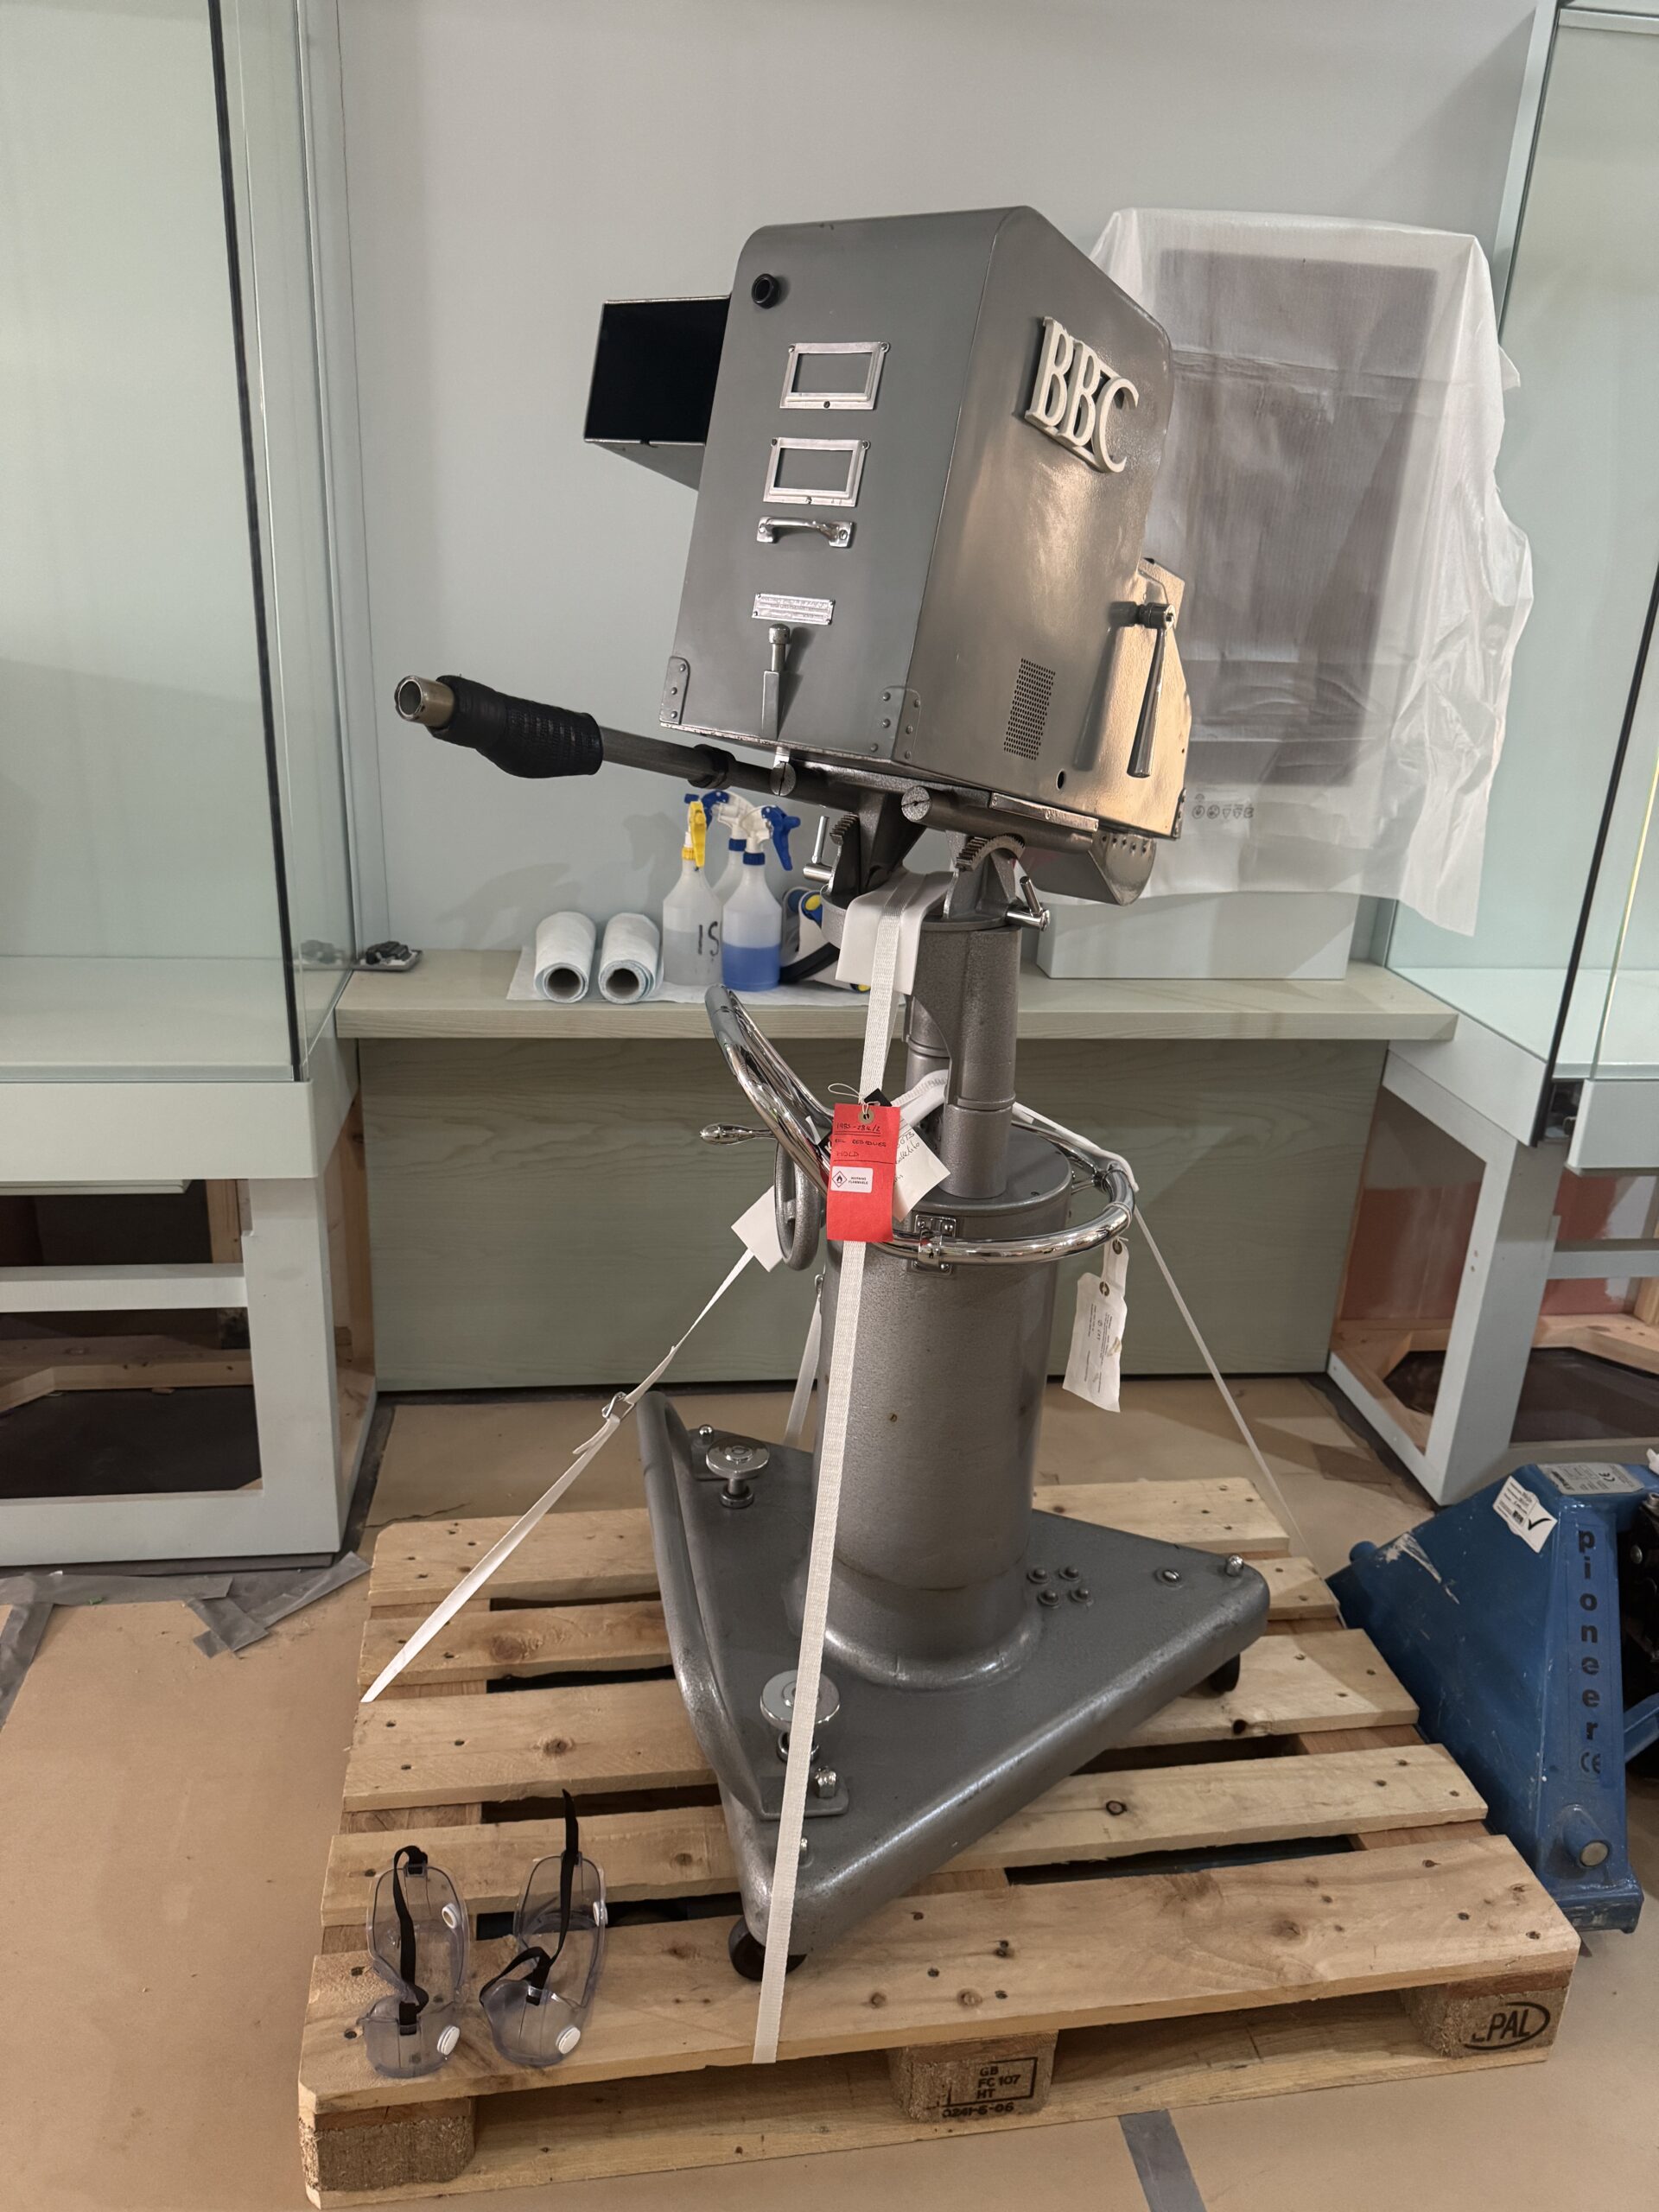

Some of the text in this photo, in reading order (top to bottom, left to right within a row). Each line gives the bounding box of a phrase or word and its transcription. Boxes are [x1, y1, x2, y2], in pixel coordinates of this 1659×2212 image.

[1025, 316, 1140, 474] BBC
[1579, 1529, 1600, 1740] pioneer
[980, 2066, 999, 2076] GB
[978, 2075, 1021, 2088] FC 107
[976, 2088, 995, 2099] HT
